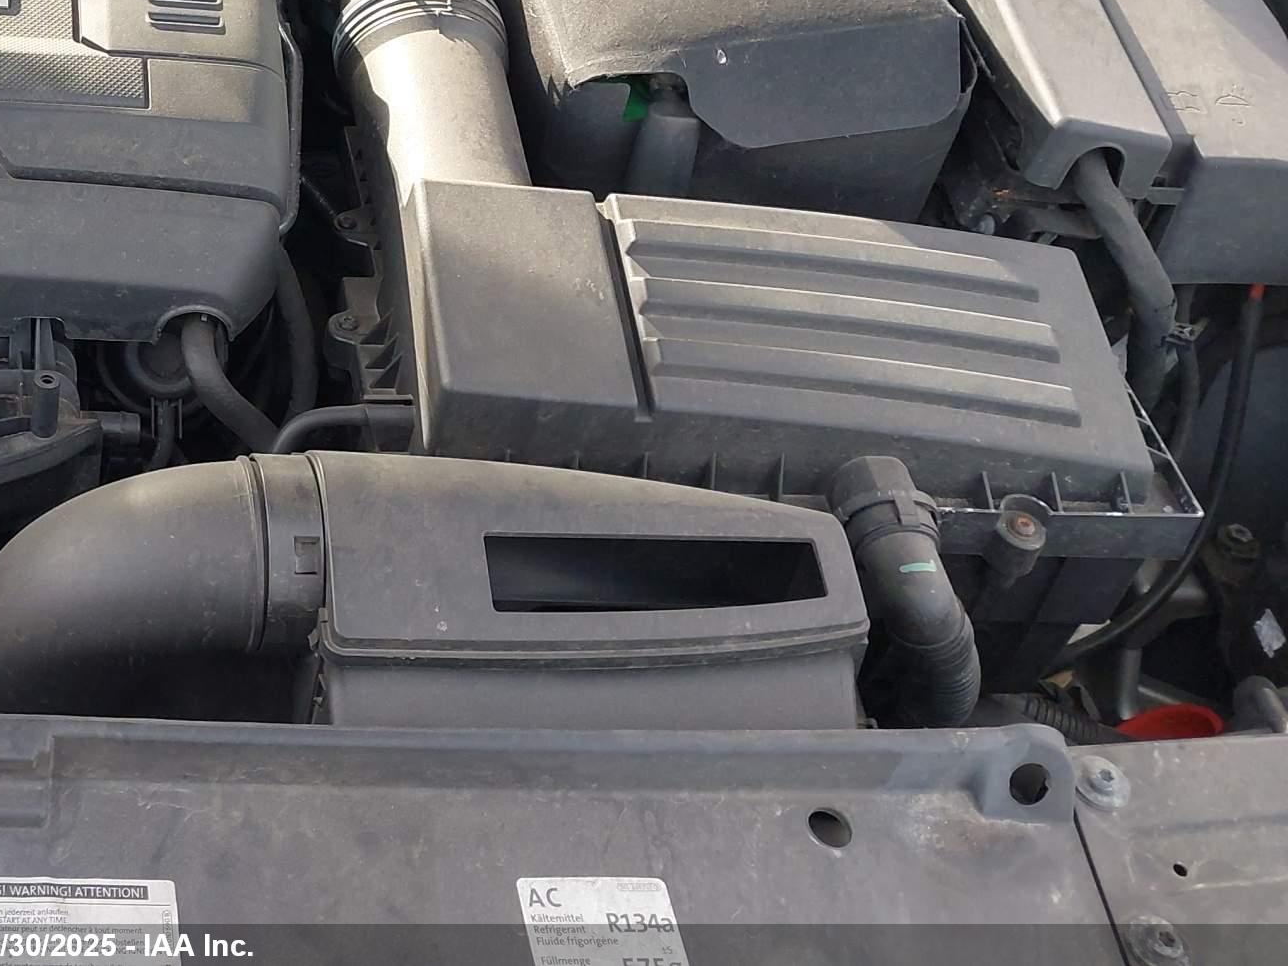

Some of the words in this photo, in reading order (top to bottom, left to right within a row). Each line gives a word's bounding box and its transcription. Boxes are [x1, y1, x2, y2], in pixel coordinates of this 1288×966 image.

[10, 886, 72, 898] WARNING!
[75, 888, 144, 899] ATTENTION!
[529, 887, 562, 908] AC
[0, 916, 20, 924] START
[22, 916, 31, 924] AT
[32, 916, 48, 924] ANY
[531, 913, 584, 923] Kältemittel
[606, 912, 675, 934] R134a
[534, 925, 586, 936] Refrigerant
[537, 936, 564, 946] Fluide
